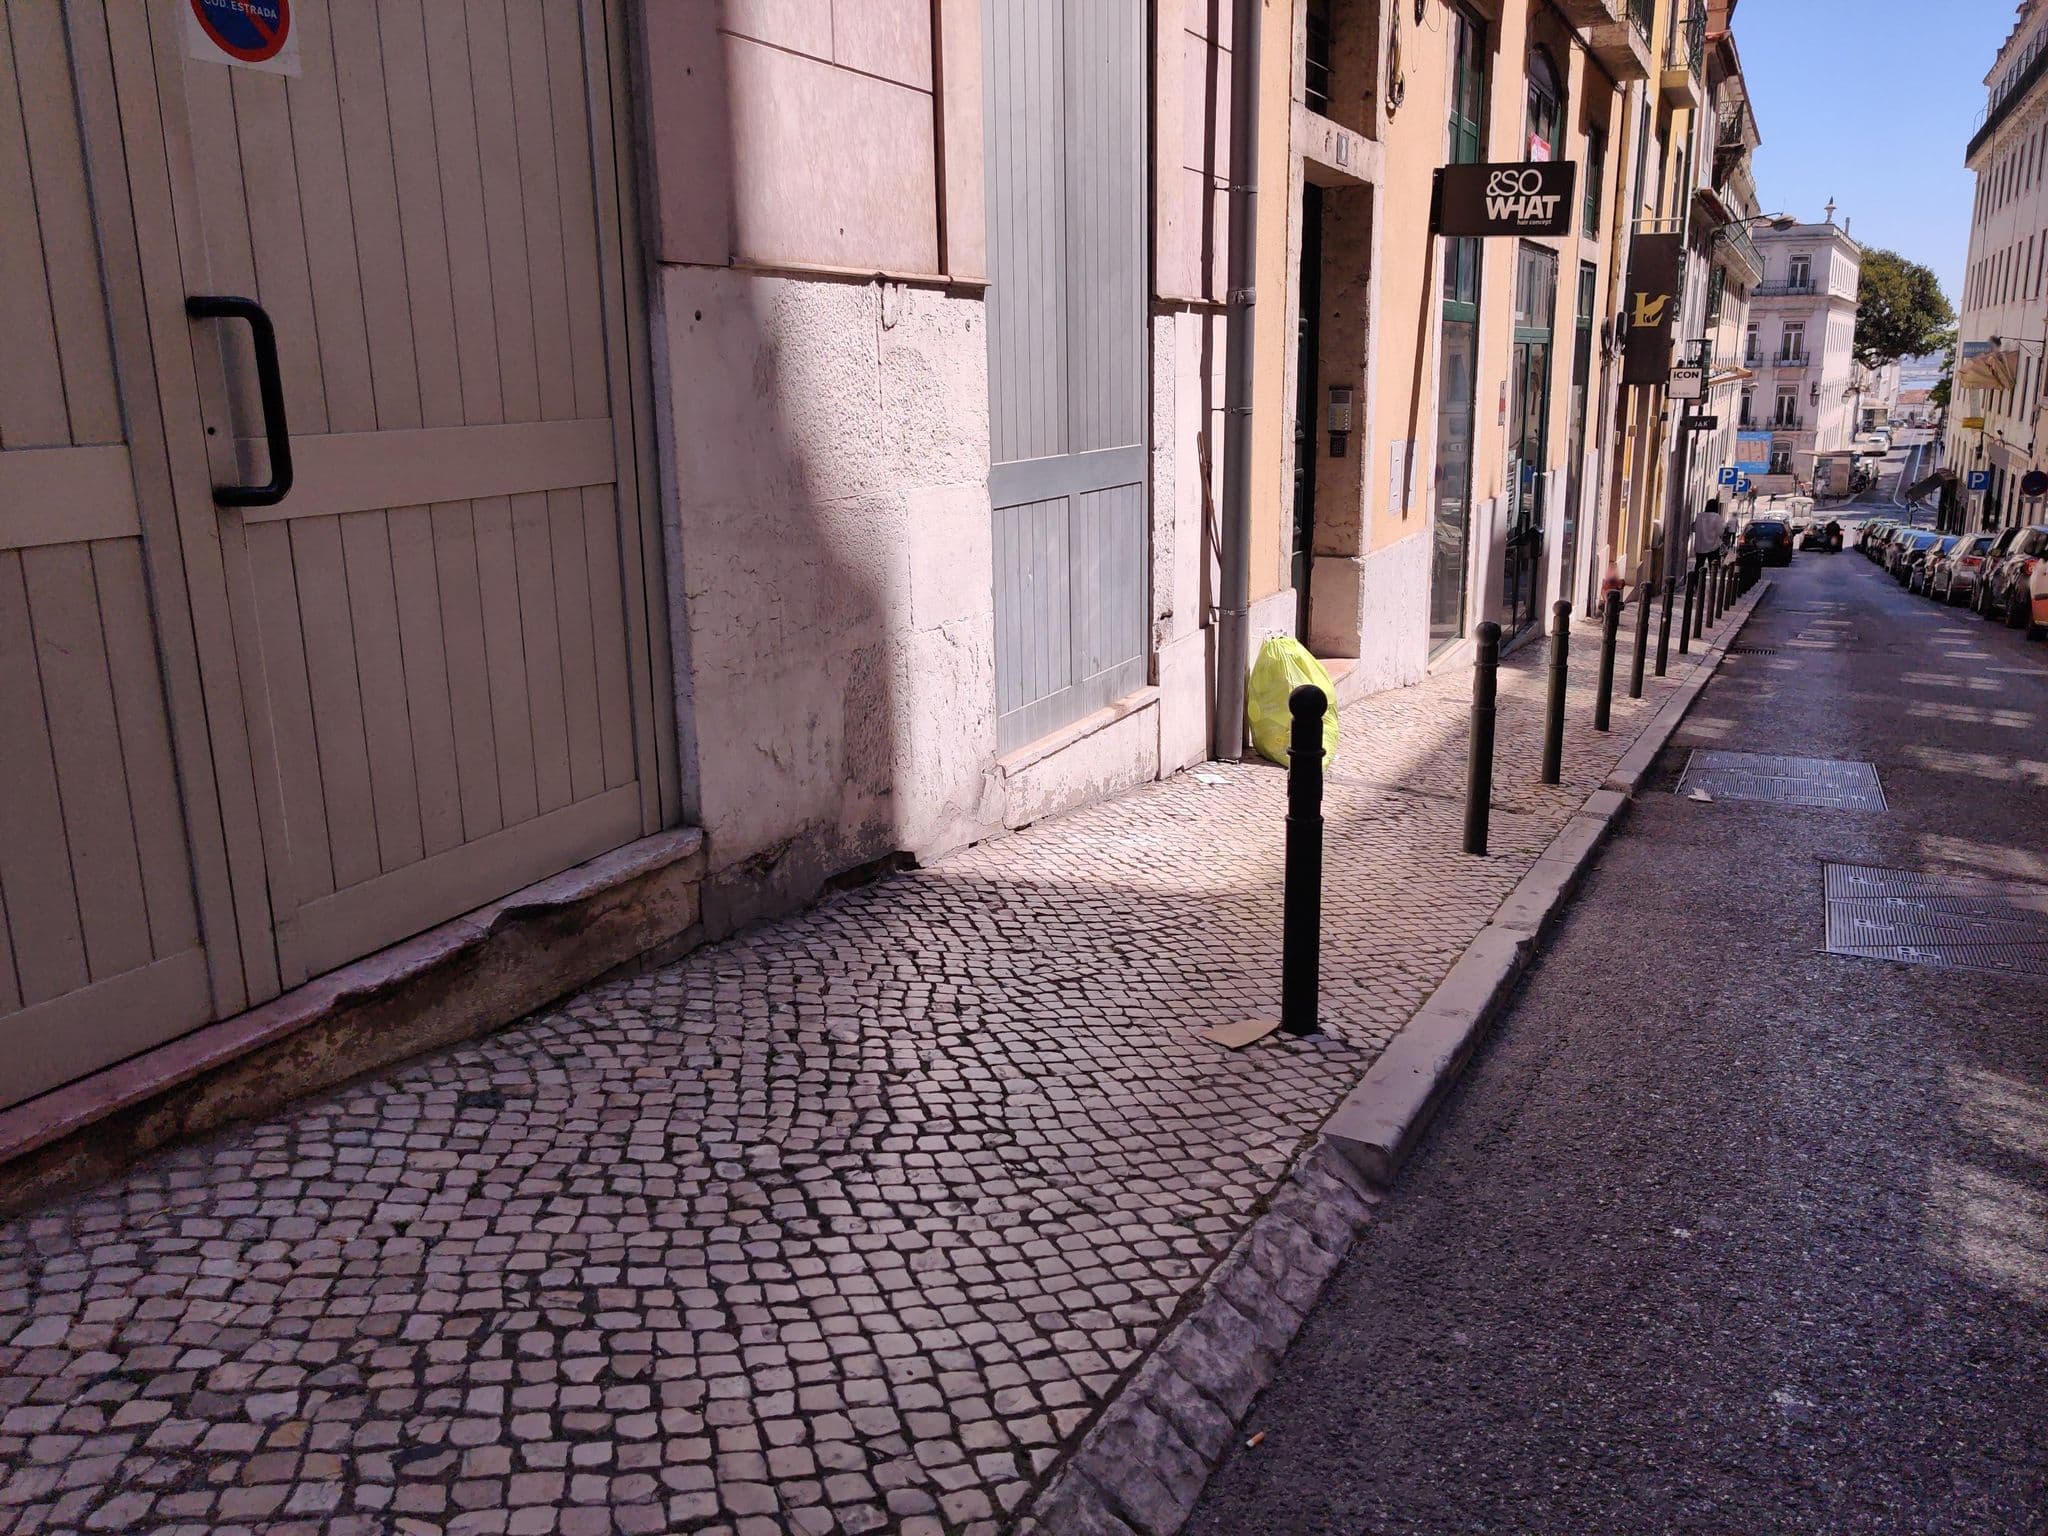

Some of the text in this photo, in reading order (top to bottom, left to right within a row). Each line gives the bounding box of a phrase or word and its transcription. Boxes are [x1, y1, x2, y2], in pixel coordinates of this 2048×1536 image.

[231, 1, 278, 19] ESTRADA
[1486, 168, 1543, 196] &SO
[1485, 195, 1561, 220] WHAT
[1529, 219, 1553, 227] concept
[1722, 469, 1734, 484] P
[1971, 473, 1984, 488] P
[1736, 479, 1746, 491] P
